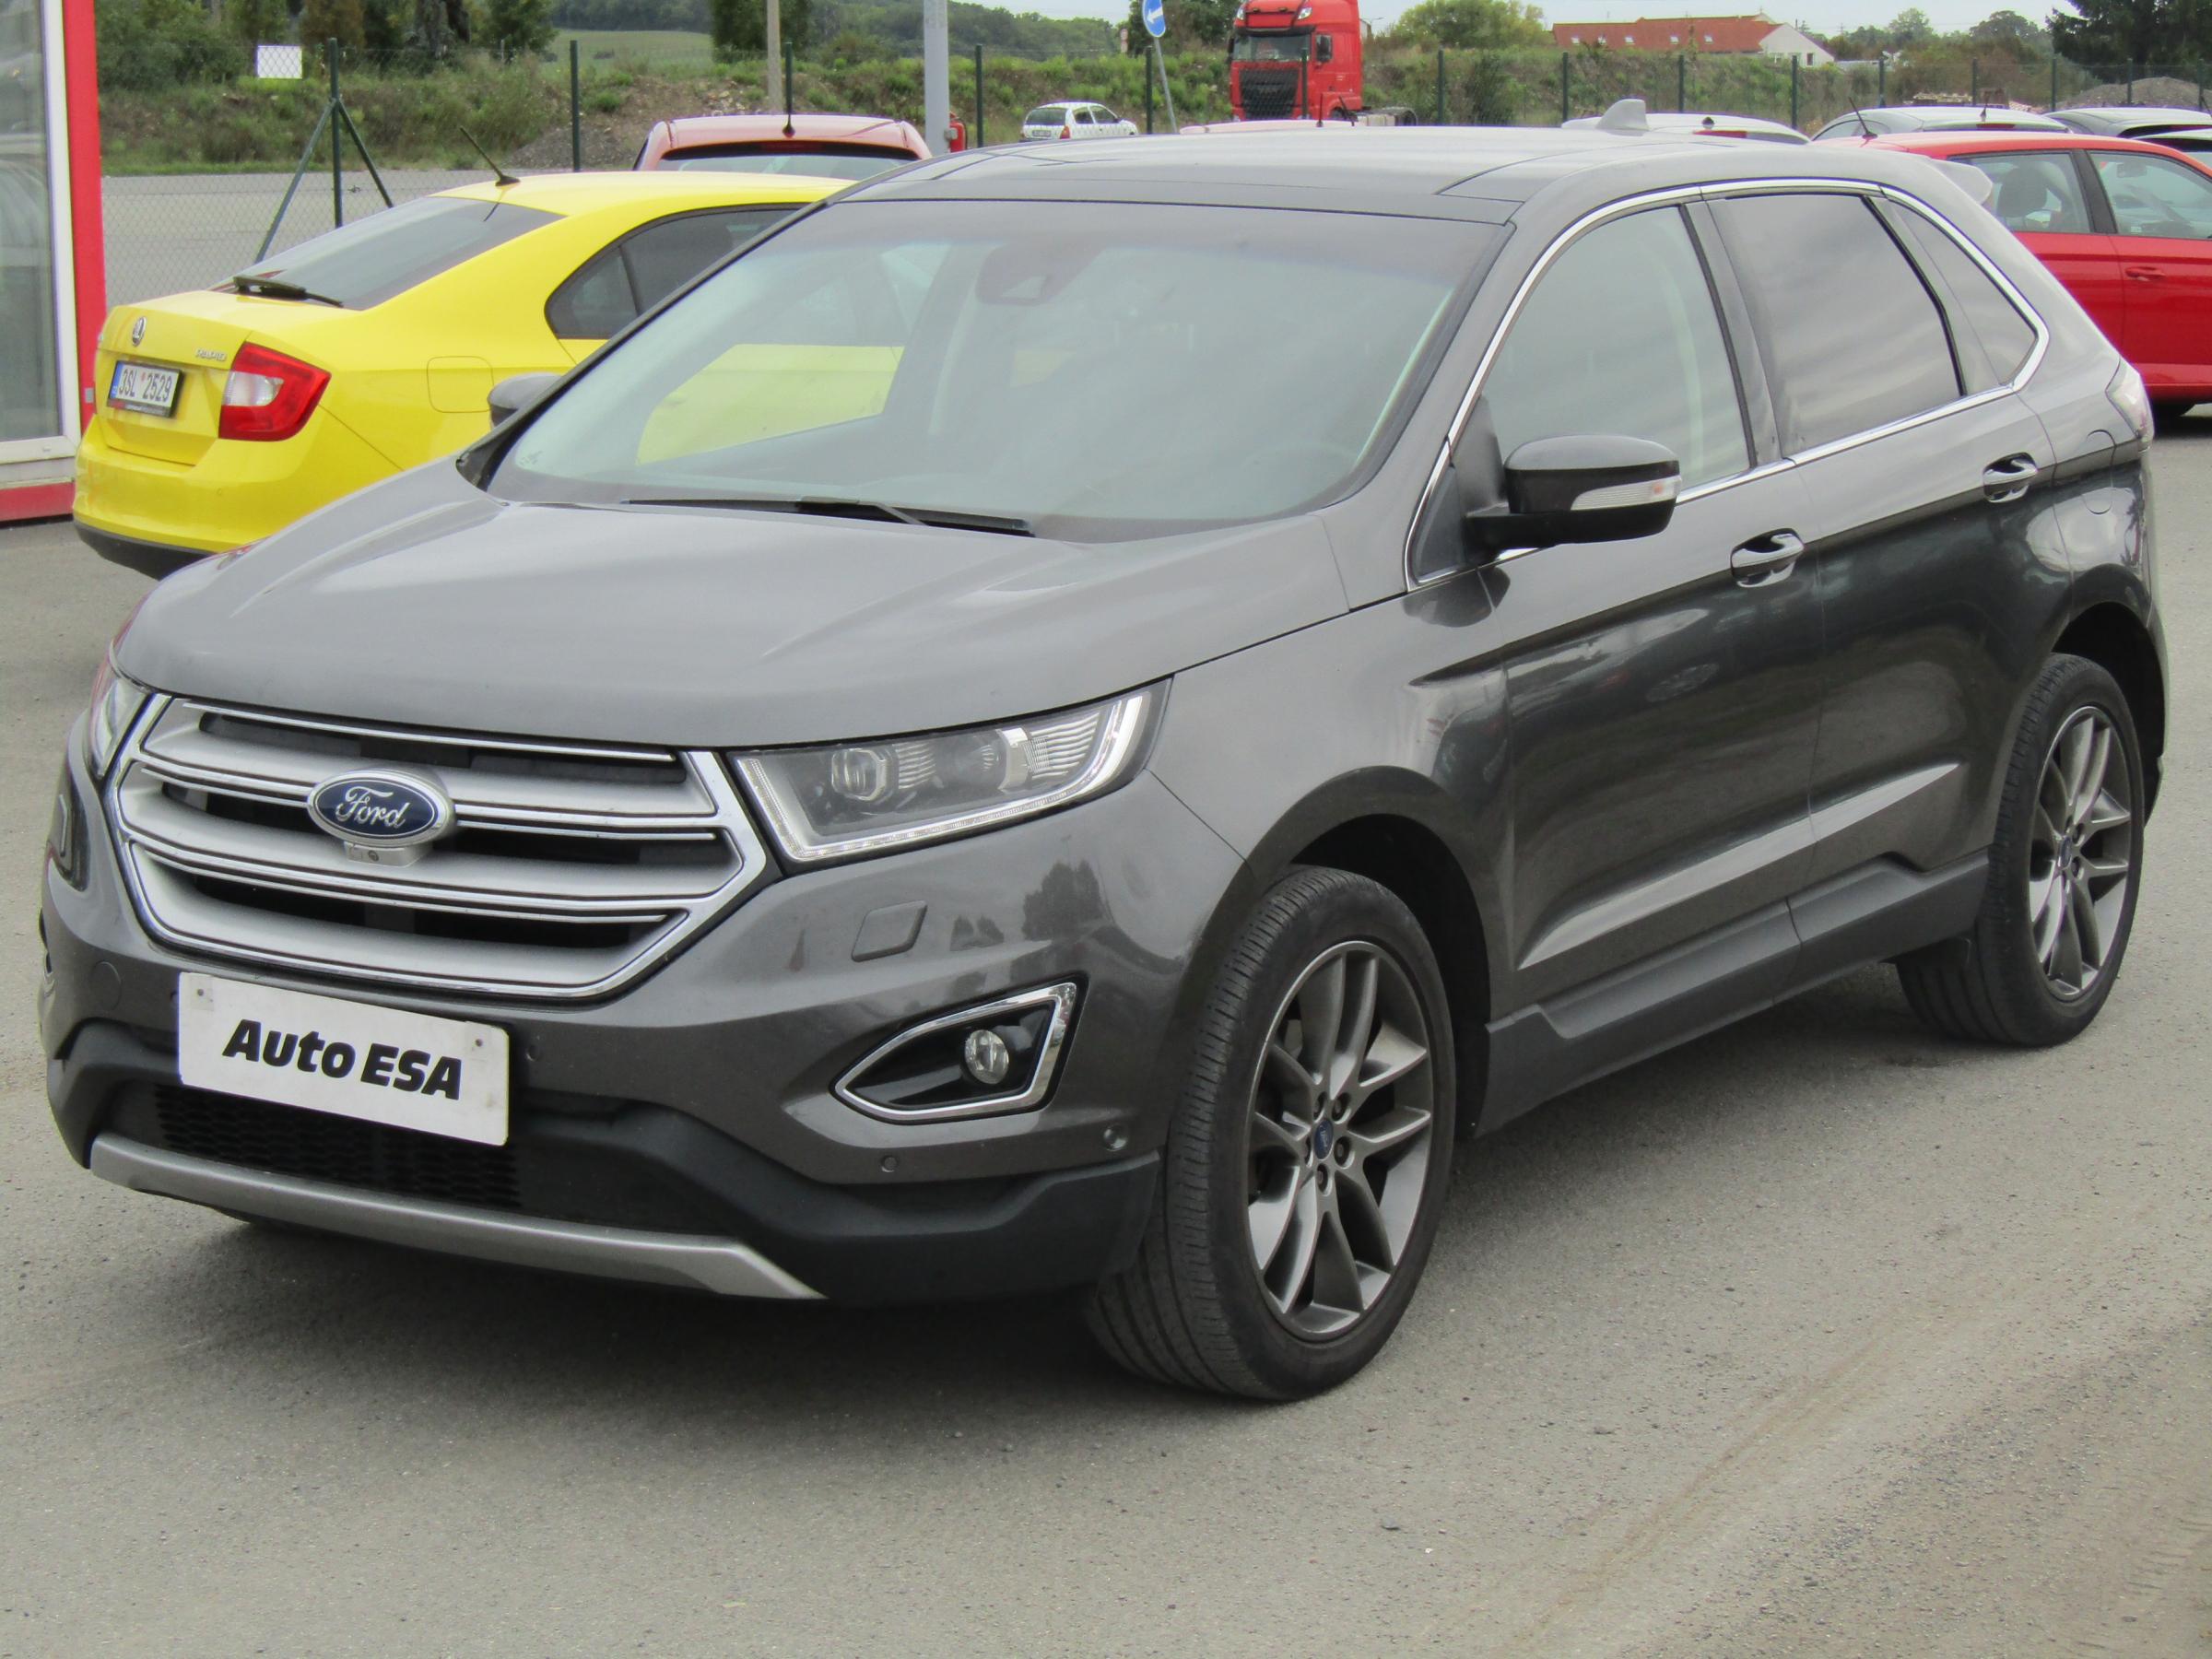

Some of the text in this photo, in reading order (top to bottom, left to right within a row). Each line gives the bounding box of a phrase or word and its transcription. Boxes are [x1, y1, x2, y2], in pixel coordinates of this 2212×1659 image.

[142, 372, 172, 402] 2529
[335, 785, 410, 829] Ford
[222, 1018, 463, 1100] Auto ESA
